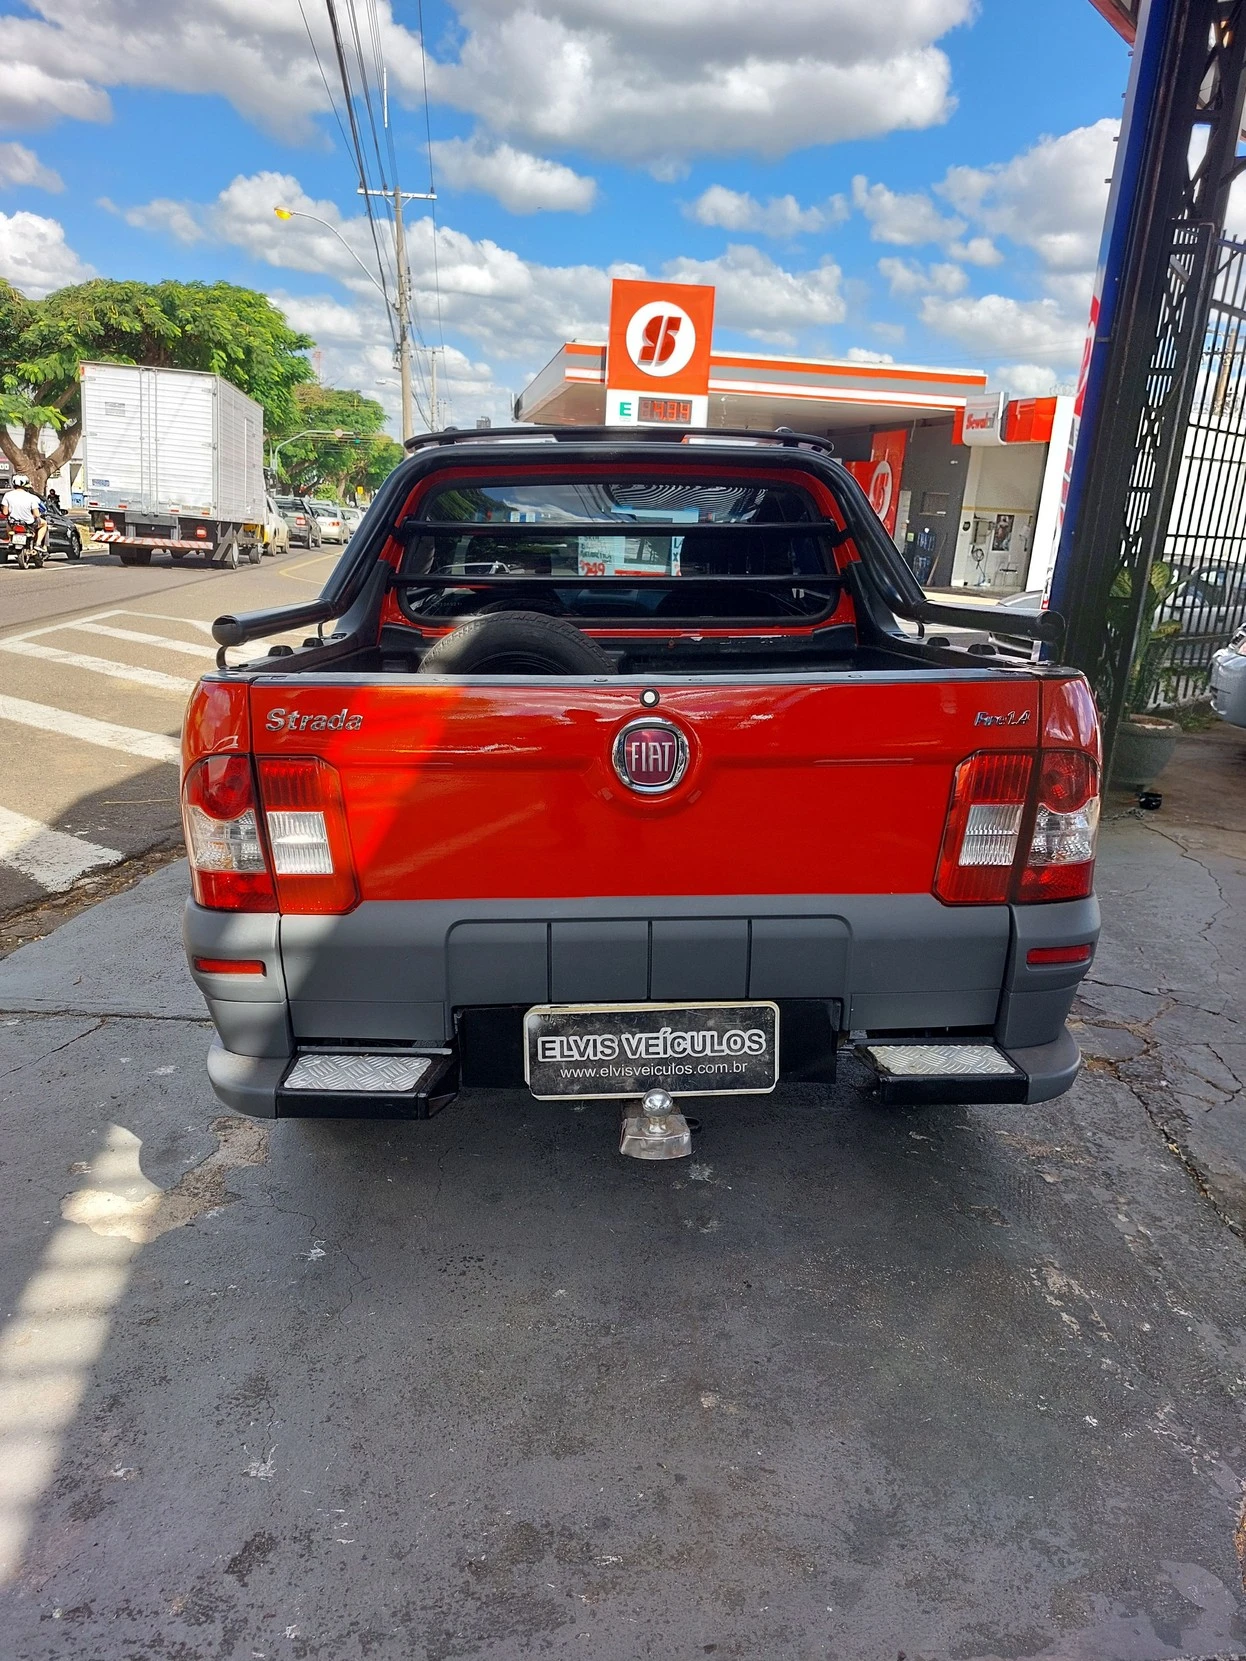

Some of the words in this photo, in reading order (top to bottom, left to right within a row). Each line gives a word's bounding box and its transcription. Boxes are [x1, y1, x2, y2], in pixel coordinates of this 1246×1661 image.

[619, 401, 632, 416] E
[265, 708, 364, 731] Strada
[631, 742, 672, 772] FIAT
[538, 1034, 618, 1062] ELVIS
[621, 1027, 767, 1059] VEÍCULOS
[560, 1061, 748, 1079] www.elvisveiculos.com.br
